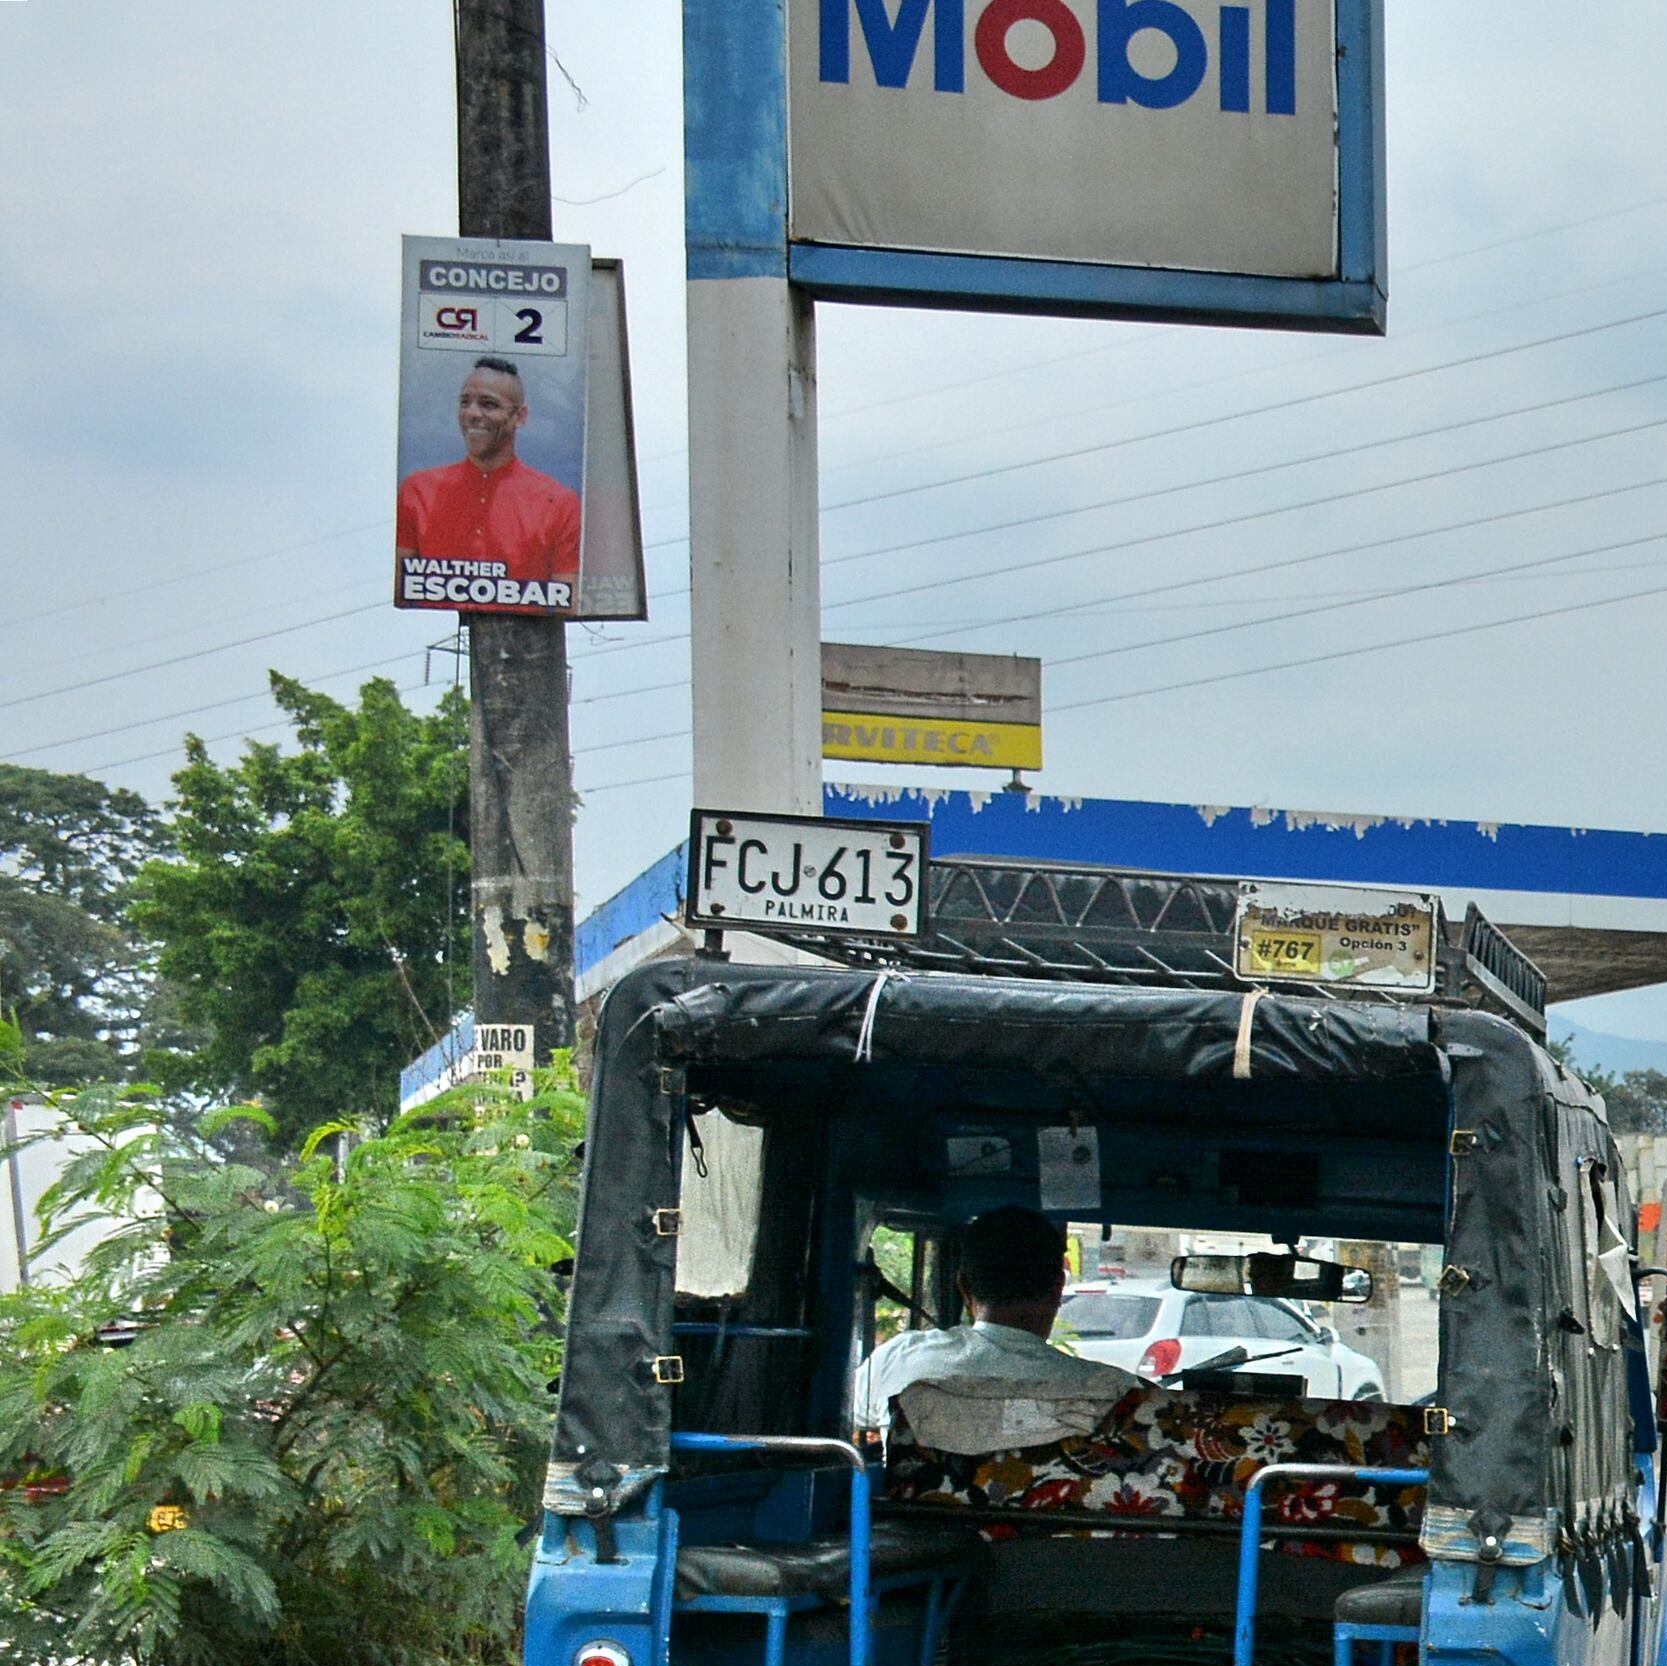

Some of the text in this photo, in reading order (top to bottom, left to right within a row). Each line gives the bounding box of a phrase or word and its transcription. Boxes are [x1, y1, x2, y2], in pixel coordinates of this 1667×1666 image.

[819, 0, 1296, 115] Mobil
[429, 266, 560, 292] CONCEJO
[514, 308, 543, 345] 2
[404, 558, 506, 577] WALTHER
[404, 576, 572, 607] ESCOBAR
[765, 899, 849, 923] PALMIRA
[1259, 939, 1314, 960] #767
[1398, 939, 1407, 951] 3
[478, 1054, 502, 1068] POR
